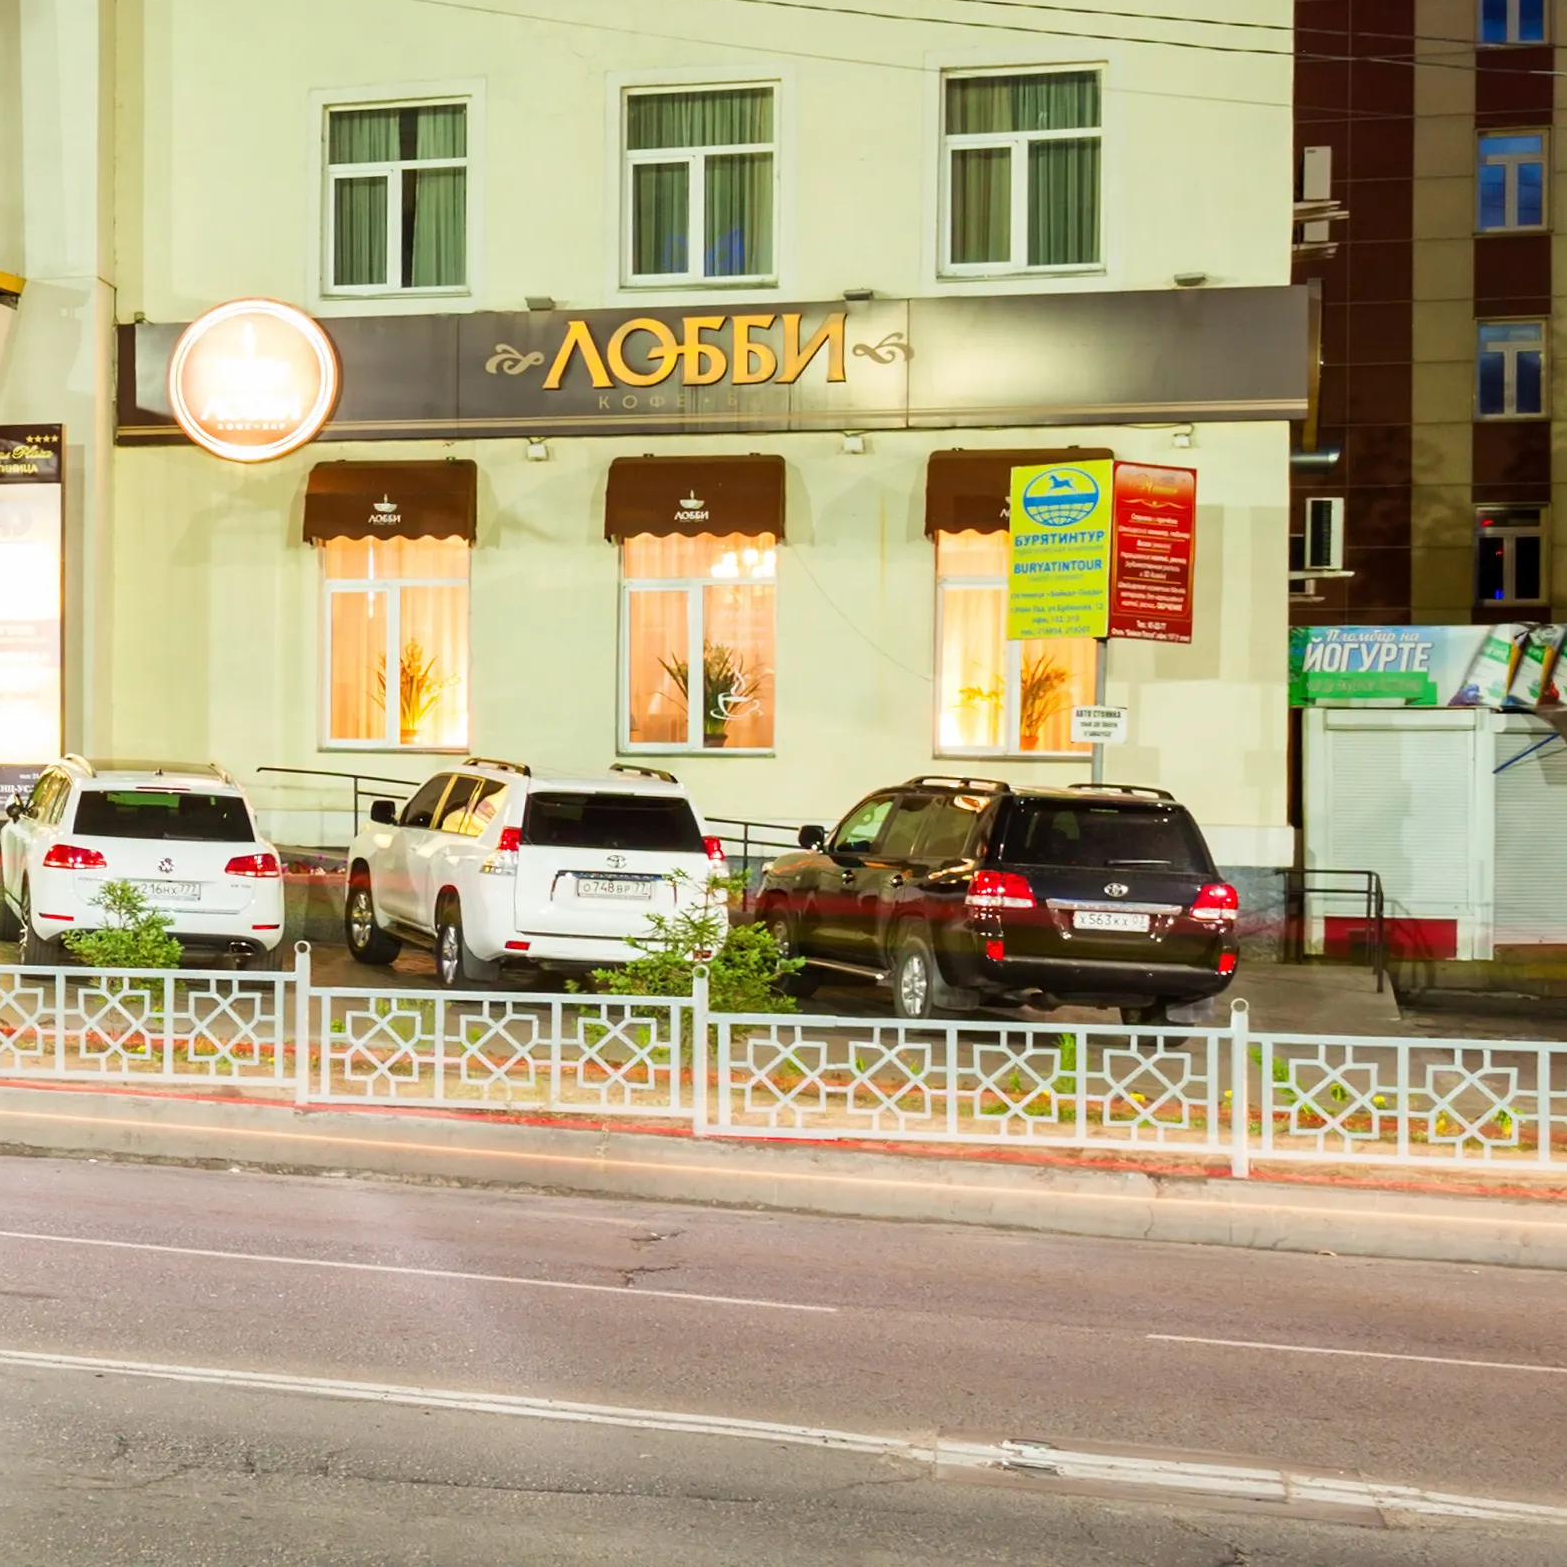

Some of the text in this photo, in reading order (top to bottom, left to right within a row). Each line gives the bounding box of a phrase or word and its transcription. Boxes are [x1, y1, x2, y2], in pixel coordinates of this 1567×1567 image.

[542, 312, 848, 390] ЛОББИ
[673, 510, 709, 521] ЛОББИ
[1014, 530, 1105, 548] БУРЯТИНТУР
[1013, 558, 1103, 575] BURYATINTOUR
[1399, 632, 1420, 642] на
[1302, 636, 1434, 672] ЙОГУРТЕ
